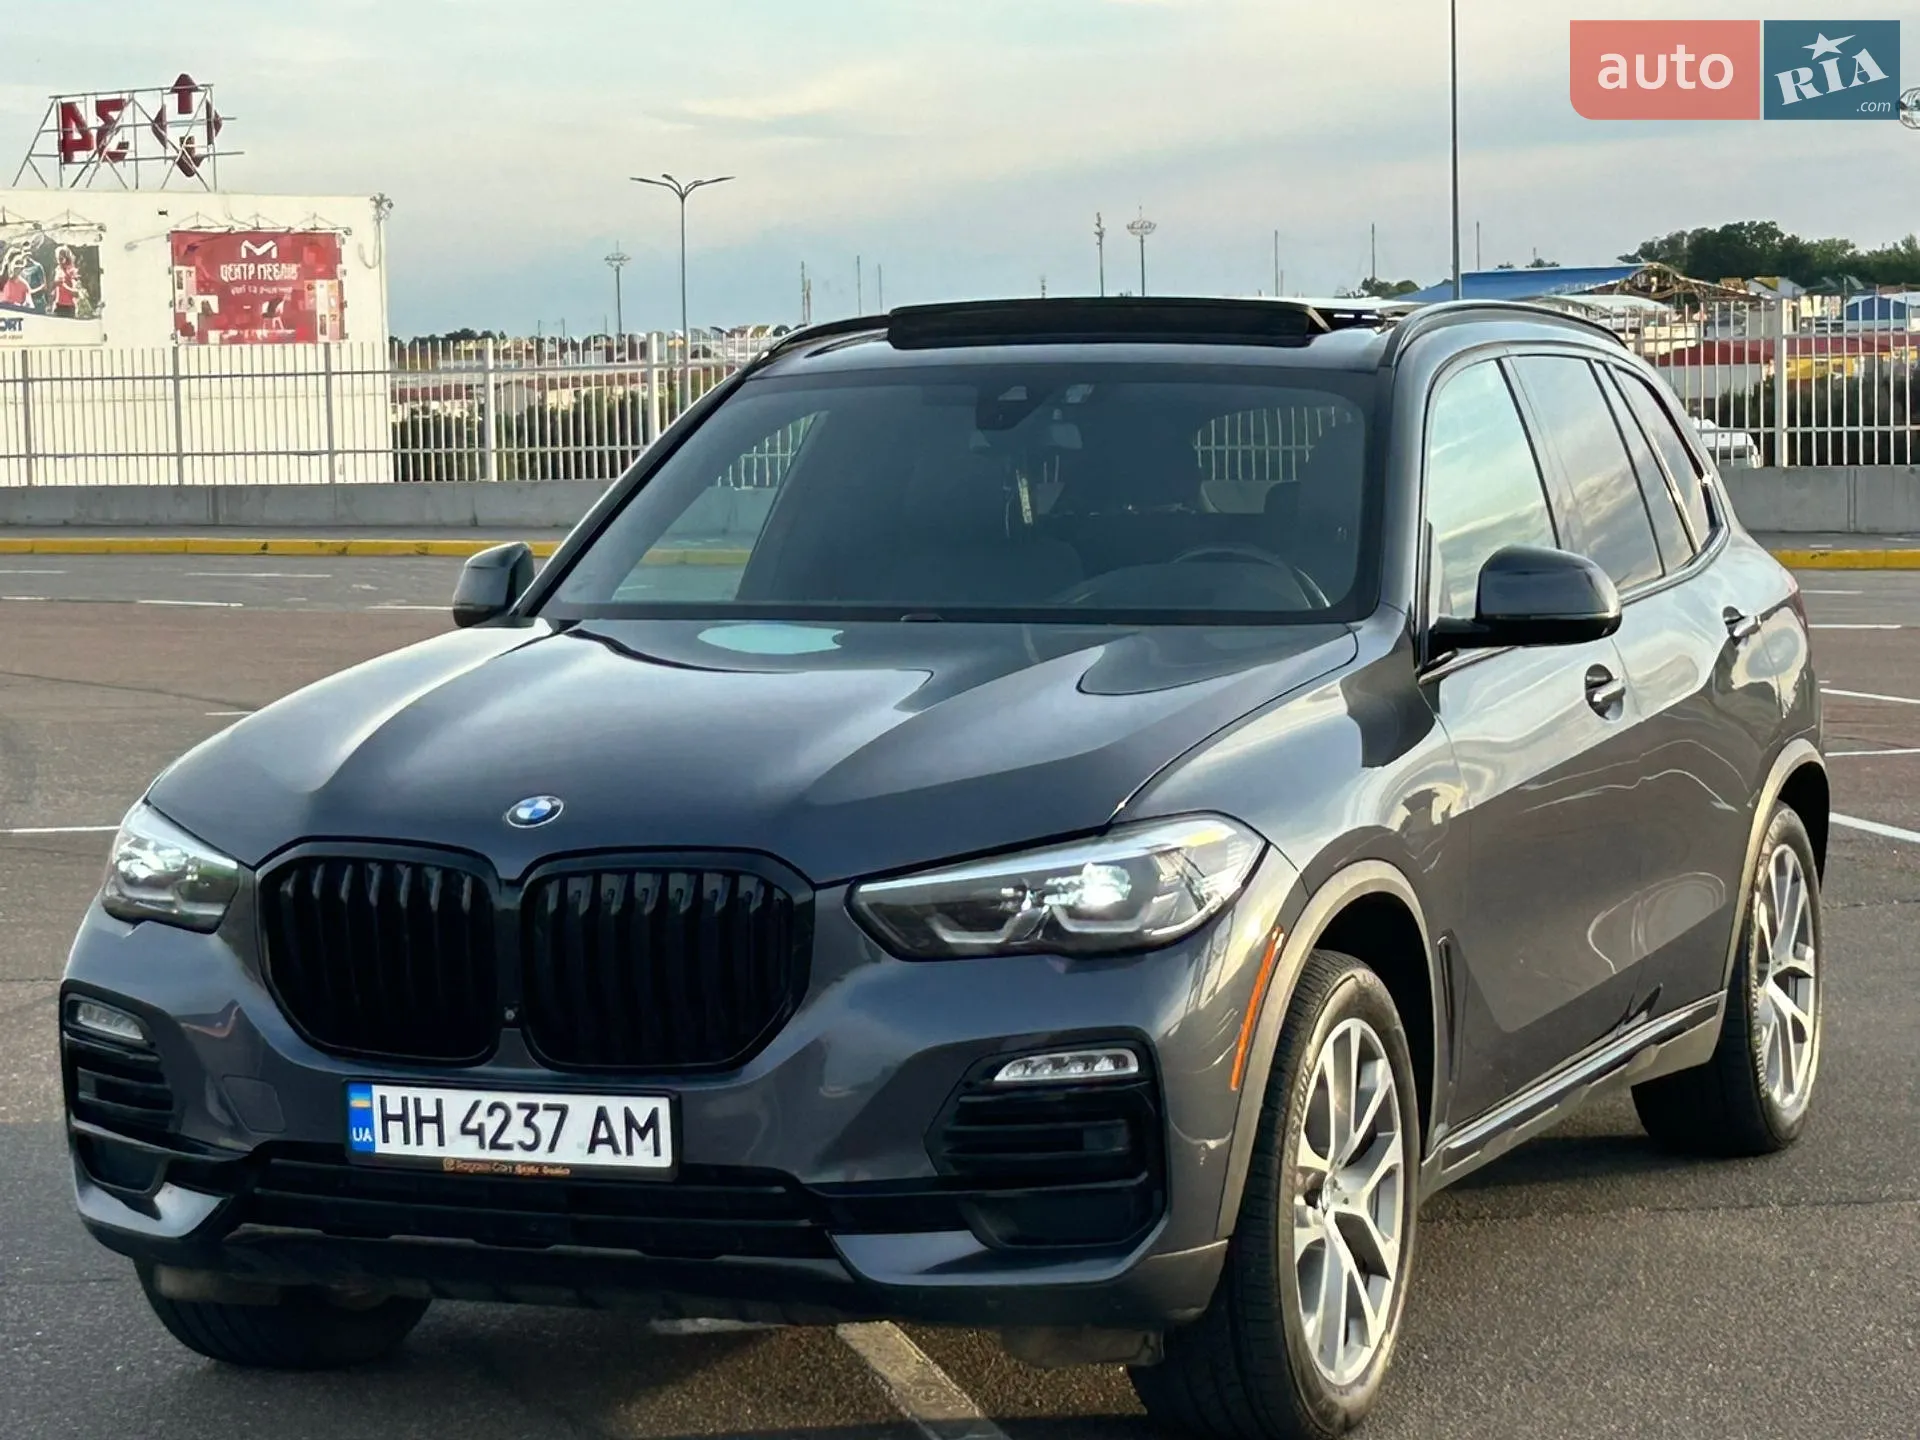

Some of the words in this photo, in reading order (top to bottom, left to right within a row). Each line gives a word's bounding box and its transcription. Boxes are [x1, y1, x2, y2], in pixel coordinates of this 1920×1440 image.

[352, 1128, 373, 1143] UA
[379, 1094, 446, 1147] HH
[459, 1099, 569, 1153] 4237
[587, 1105, 660, 1157] AM
